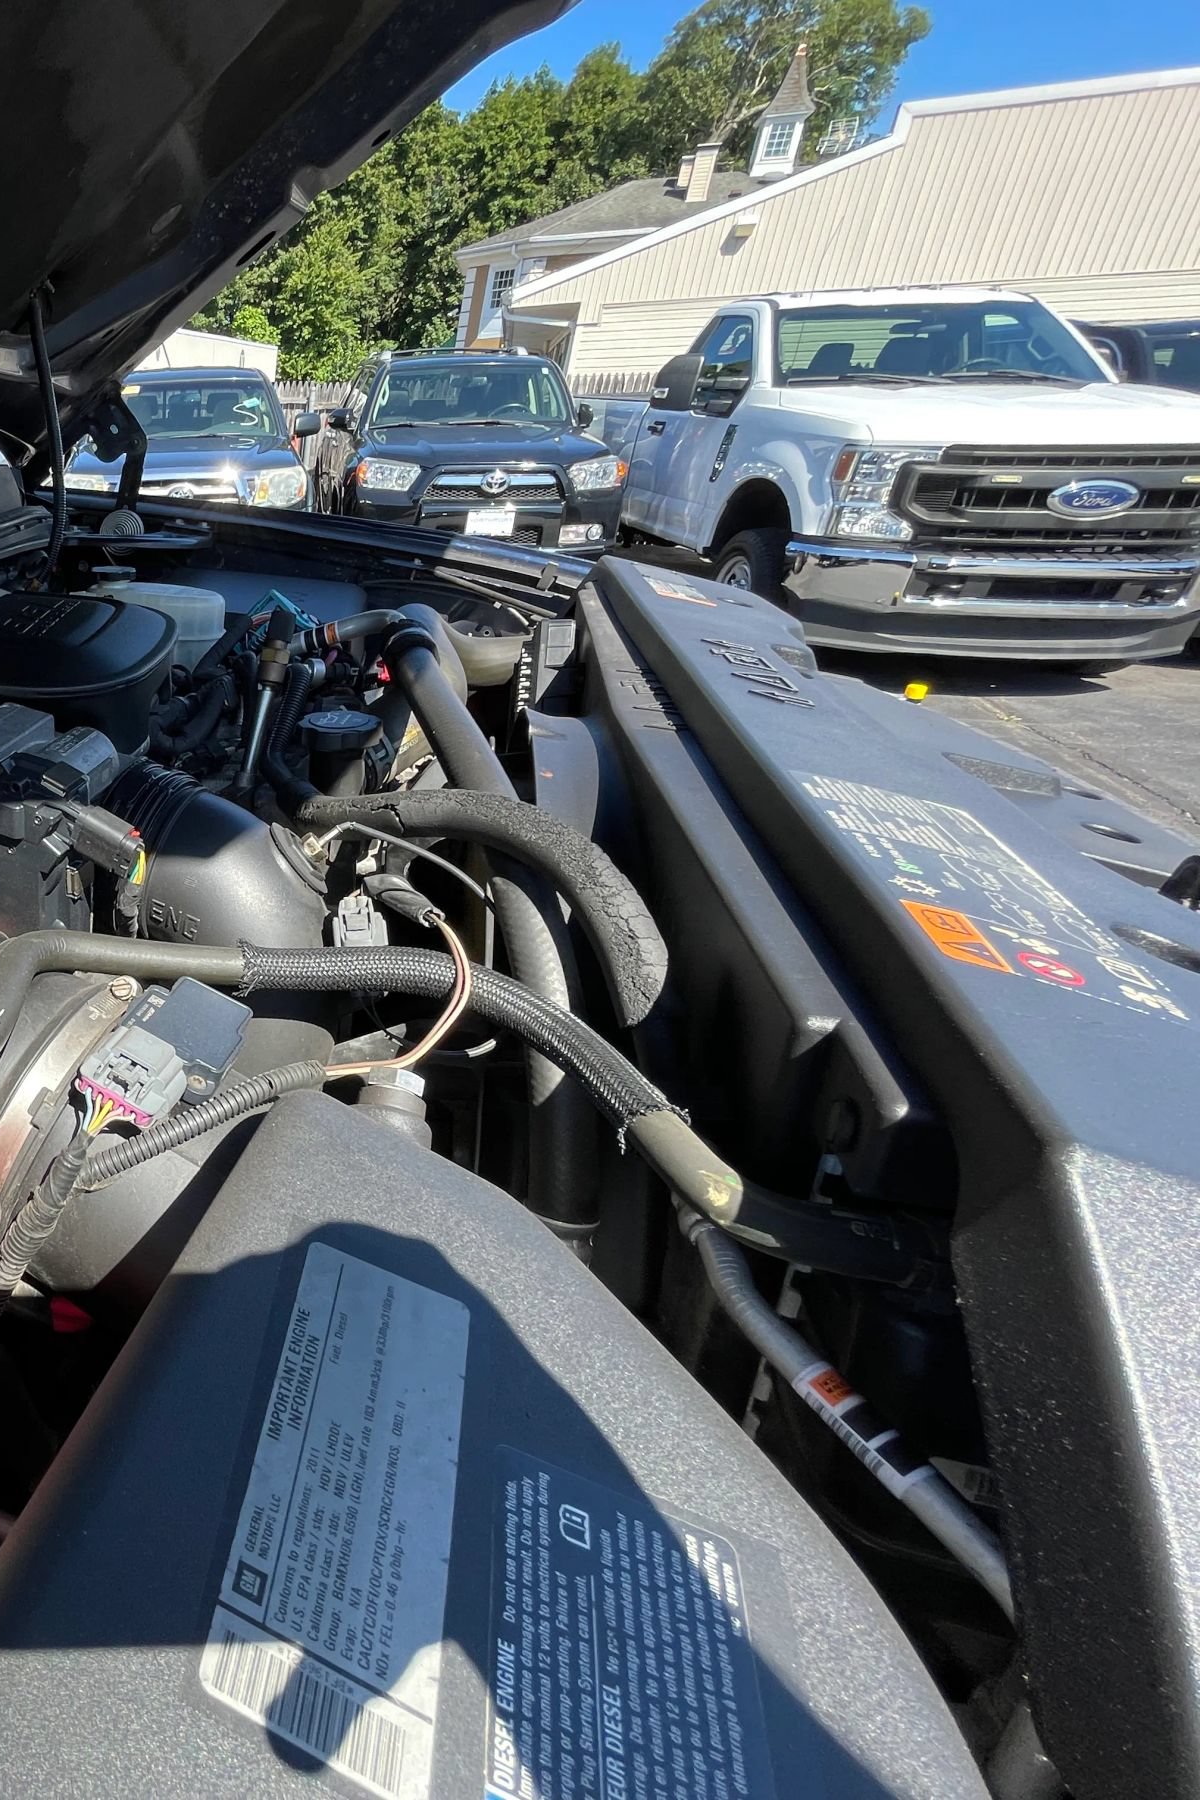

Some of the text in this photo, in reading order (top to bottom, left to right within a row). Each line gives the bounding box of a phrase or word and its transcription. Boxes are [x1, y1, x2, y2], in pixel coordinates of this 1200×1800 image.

[1072, 490, 1117, 506] Ford
[151, 898, 201, 942] ENG
[328, 1311, 348, 1365] Fuel: Diesel
[265, 1306, 310, 1441] IMPORTANT ENGINE
[286, 1333, 320, 1431] INFORMATION
[391, 1410, 405, 1438] OBD:
[339, 1432, 354, 1462] ULEV
[318, 1465, 332, 1491] HDV
[332, 1470, 348, 1499] MDV
[537, 1470, 550, 1506] during
[243, 1503, 264, 1553] GENERAL
[257, 1493, 281, 1561] MOTORS LLC
[272, 1446, 320, 1623] Conforms to regulations: 2011
[322, 1604, 343, 1652] Group:
[358, 1423, 372, 1447] rate
[537, 1505, 551, 1547] system
[615, 1510, 629, 1552] moteur
[632, 1517, 646, 1561] tension
[302, 1540, 317, 1572] class
[318, 1546, 334, 1579] class
[598, 1526, 615, 1568] liquide
[619, 1552, 630, 1569] au
[649, 1528, 668, 1590] électrique
[238, 1567, 258, 1595] GM
[537, 1546, 549, 1602] electrical
[554, 1570, 566, 1585] of
[601, 1566, 613, 1584] de
[637, 1562, 649, 1587] une
[668, 1547, 684, 1584] d'une
[296, 1572, 311, 1600] EPA
[573, 1571, 587, 1612] result.
[617, 1569, 635, 1636] immédiats
[672, 1584, 688, 1621] l'aide
[289, 1602, 306, 1633] U.S.
[306, 1579, 328, 1642] California
[340, 1584, 363, 1662] Evap: N/A
[538, 1602, 550, 1617] to
[555, 1585, 568, 1631] Failure
[602, 1583, 616, 1627] utiliser
[637, 1586, 657, 1649] appliquer
[693, 1596, 706, 1620] une
[493, 1476, 518, 1791] DIESEL ENGINE Do not use starting fluids.
[518, 1474, 534, 1800] Immediate engine damage can result. Do not apply
[538, 1618, 550, 1651] volts
[577, 1613, 588, 1639] can
[712, 1621, 726, 1640] de
[537, 1651, 550, 1670] 12
[605, 1653, 620, 1675] Ne
[644, 1649, 659, 1676] pas
[662, 1644, 674, 1663] au
[694, 1620, 712, 1672] résulter
[374, 1649, 390, 1681] NOx
[577, 1640, 593, 1692] System
[623, 1637, 643, 1714] dommages
[662, 1663, 677, 1699] volts
[676, 1632, 700, 1708] démarrage
[702, 1672, 715, 1691] en
[714, 1640, 737, 1697] bougies
[537, 1671, 551, 1731] nominal
[644, 1676, 659, 1698] Ne
[577, 1691, 595, 1753] Starting
[602, 1679, 623, 1754] DIESEL
[665, 1700, 680, 1720] 12
[684, 1708, 699, 1725] le
[702, 1691, 724, 1750] pourrait
[560, 1731, 571, 1750] or
[627, 1713, 643, 1744] Des
[667, 1723, 682, 1745] de
[689, 1727, 702, 1748] ou
[538, 1731, 552, 1767] than
[669, 1746, 688, 1782] plus
[723, 1710, 751, 1796] démarrage
[580, 1753, 596, 1790] Plug
[653, 1764, 666, 1785] en
